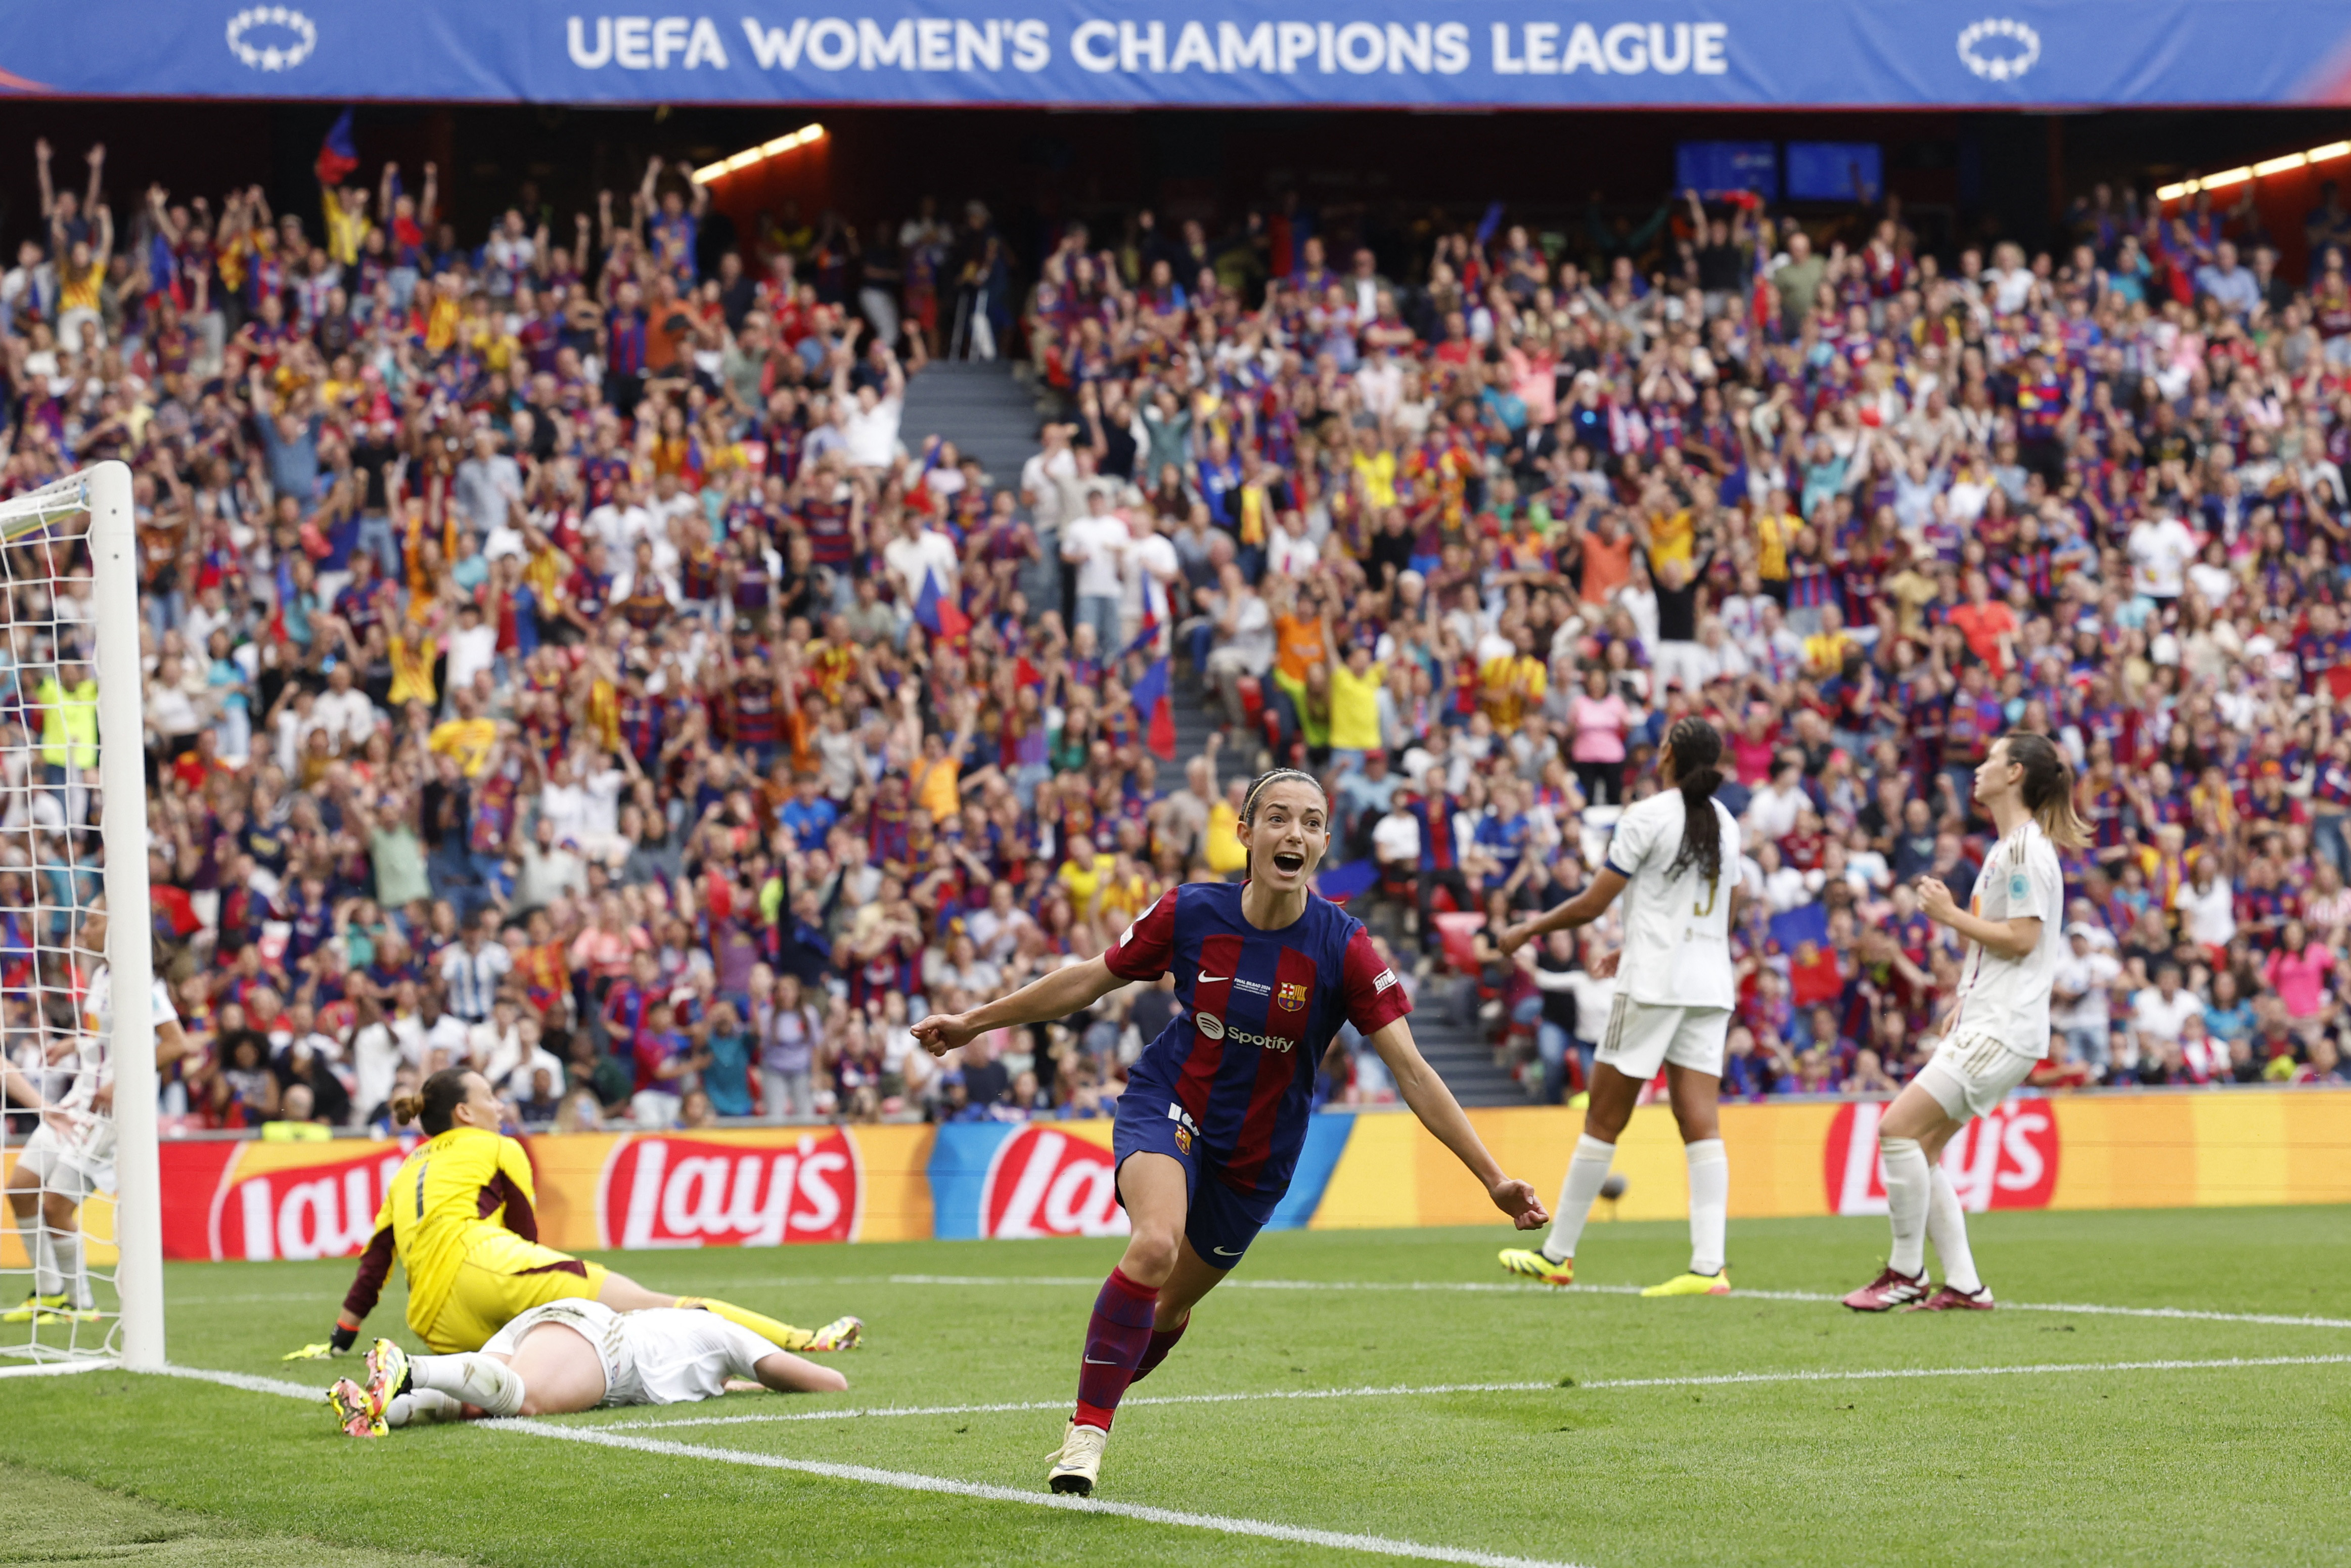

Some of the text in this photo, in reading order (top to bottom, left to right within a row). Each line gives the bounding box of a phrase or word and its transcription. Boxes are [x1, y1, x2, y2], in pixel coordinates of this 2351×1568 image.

[567, 17, 1727, 74] UEFA WOMEN'S CHAMPIONS LEAGUE
[1227, 1026, 1294, 1053] Spotify
[417, 1160, 429, 1220] 1
[621, 1133, 847, 1250] Lay's
